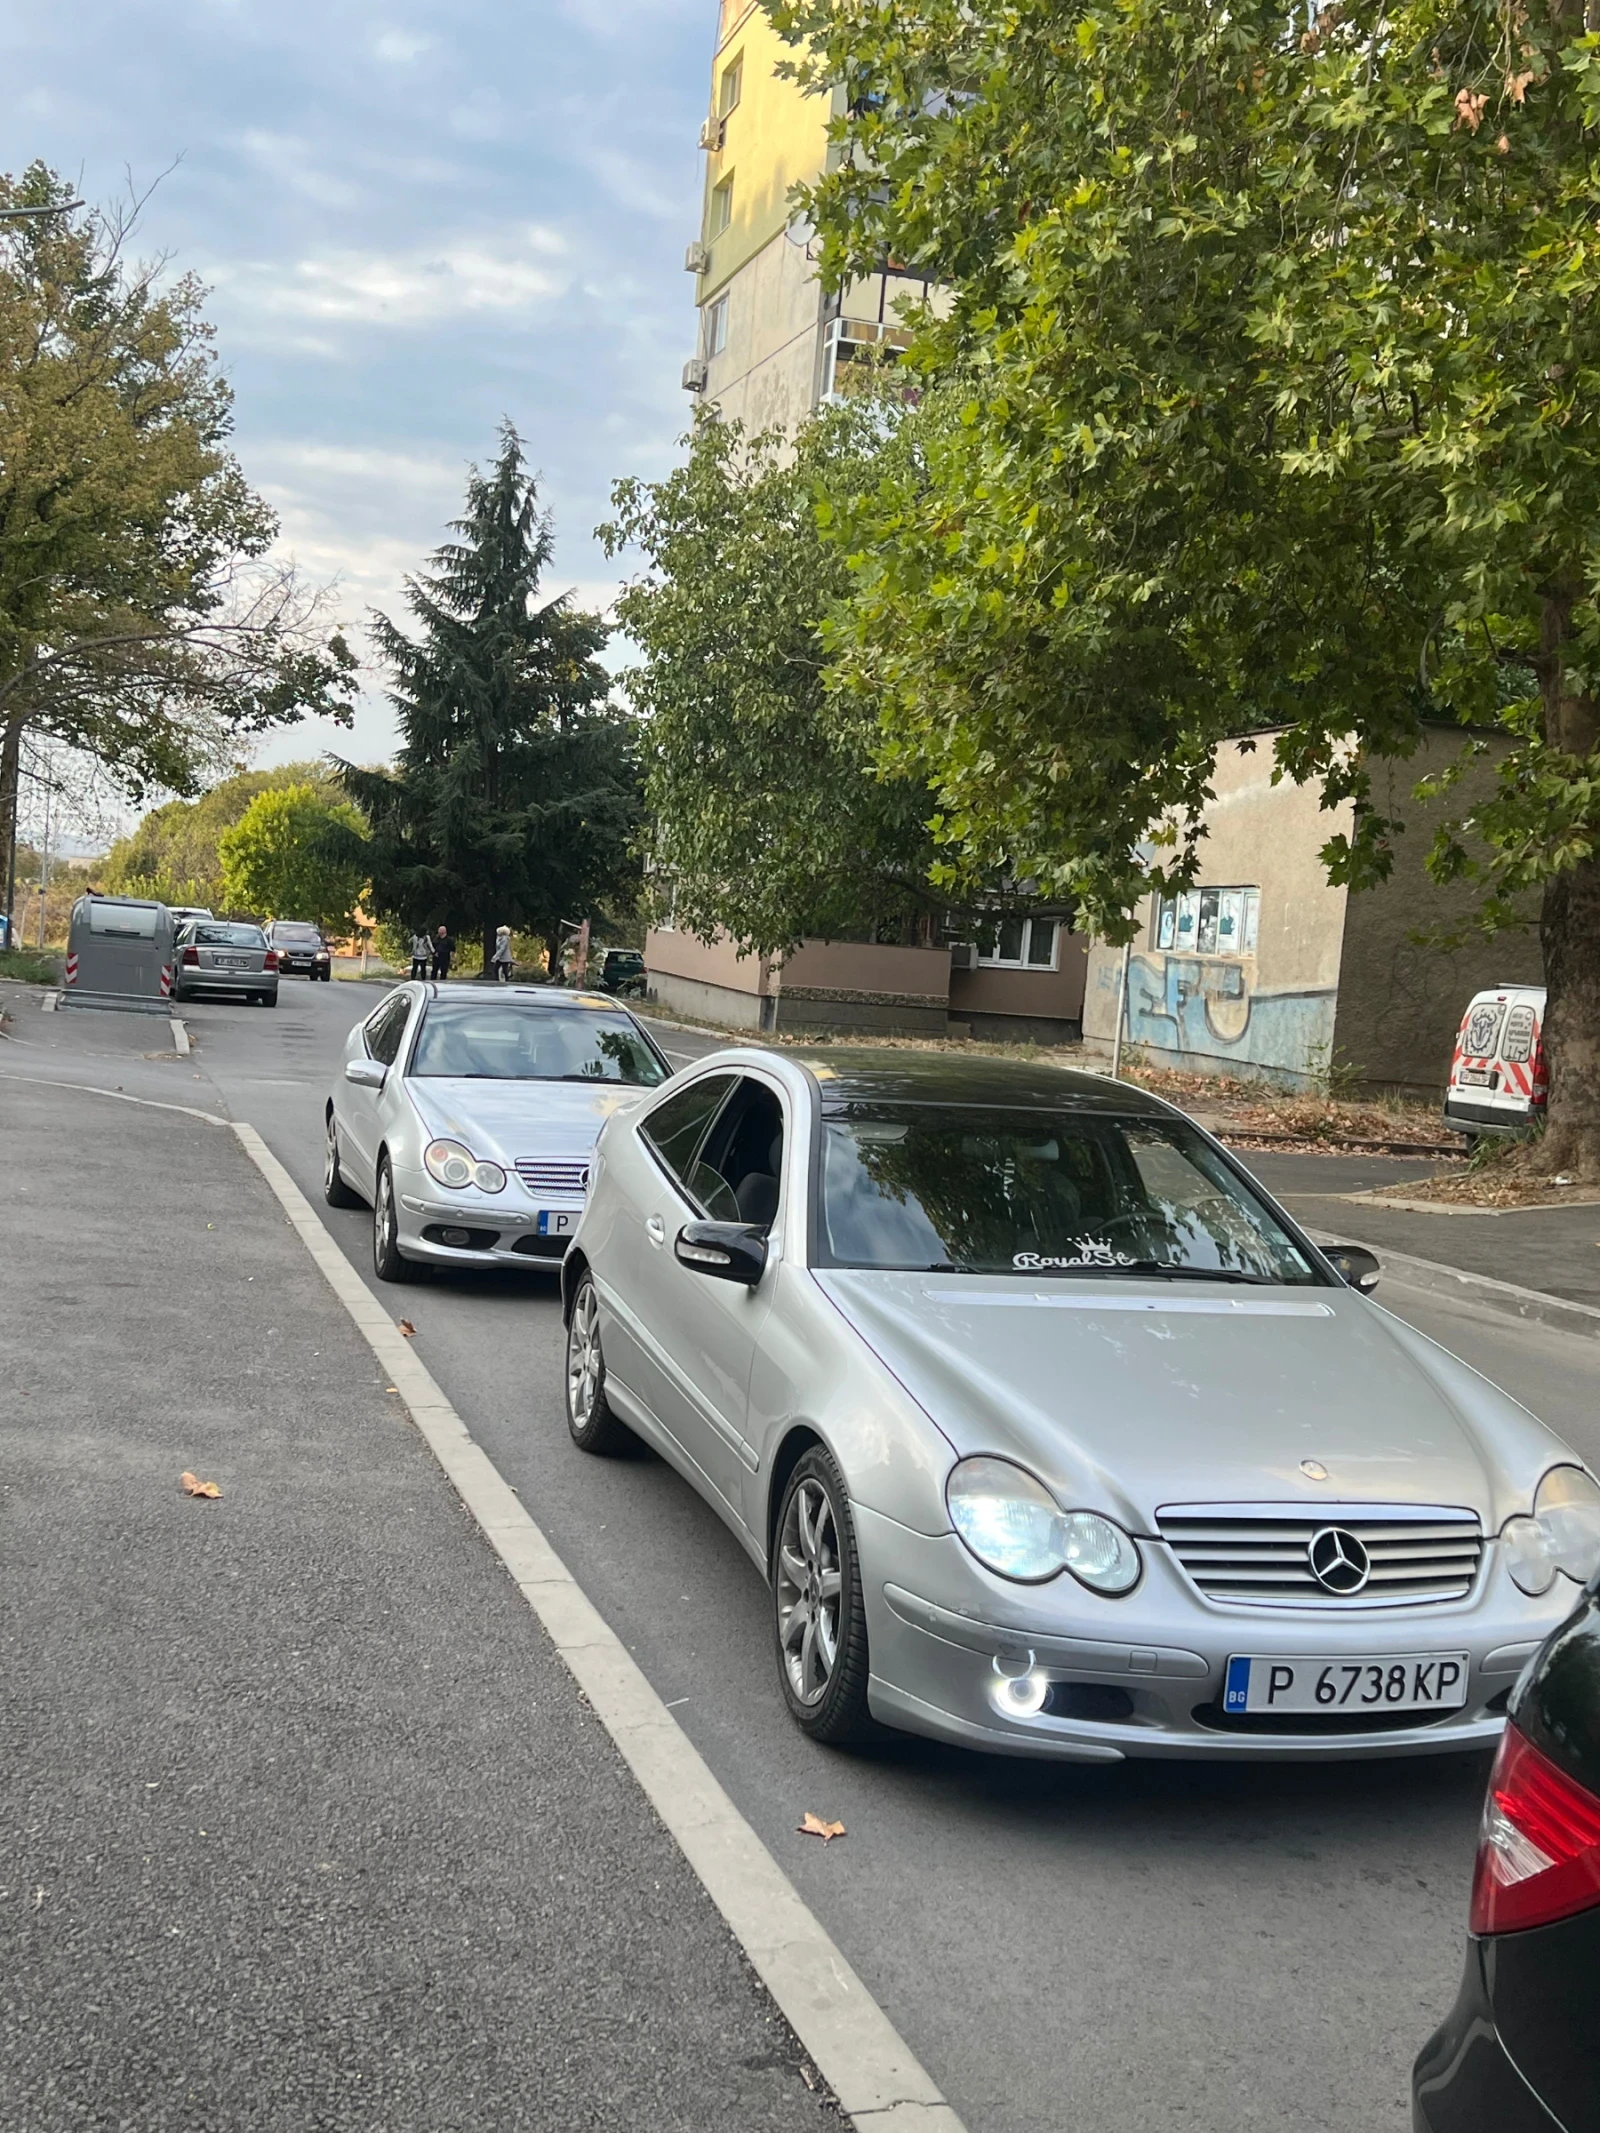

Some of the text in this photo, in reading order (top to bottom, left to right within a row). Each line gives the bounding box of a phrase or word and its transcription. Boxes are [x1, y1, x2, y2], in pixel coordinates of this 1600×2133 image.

[556, 1215, 569, 1232] P
[1012, 1251, 1175, 1270] RoyalSt
[1228, 1690, 1246, 1704] BG
[1267, 1665, 1294, 1705] P
